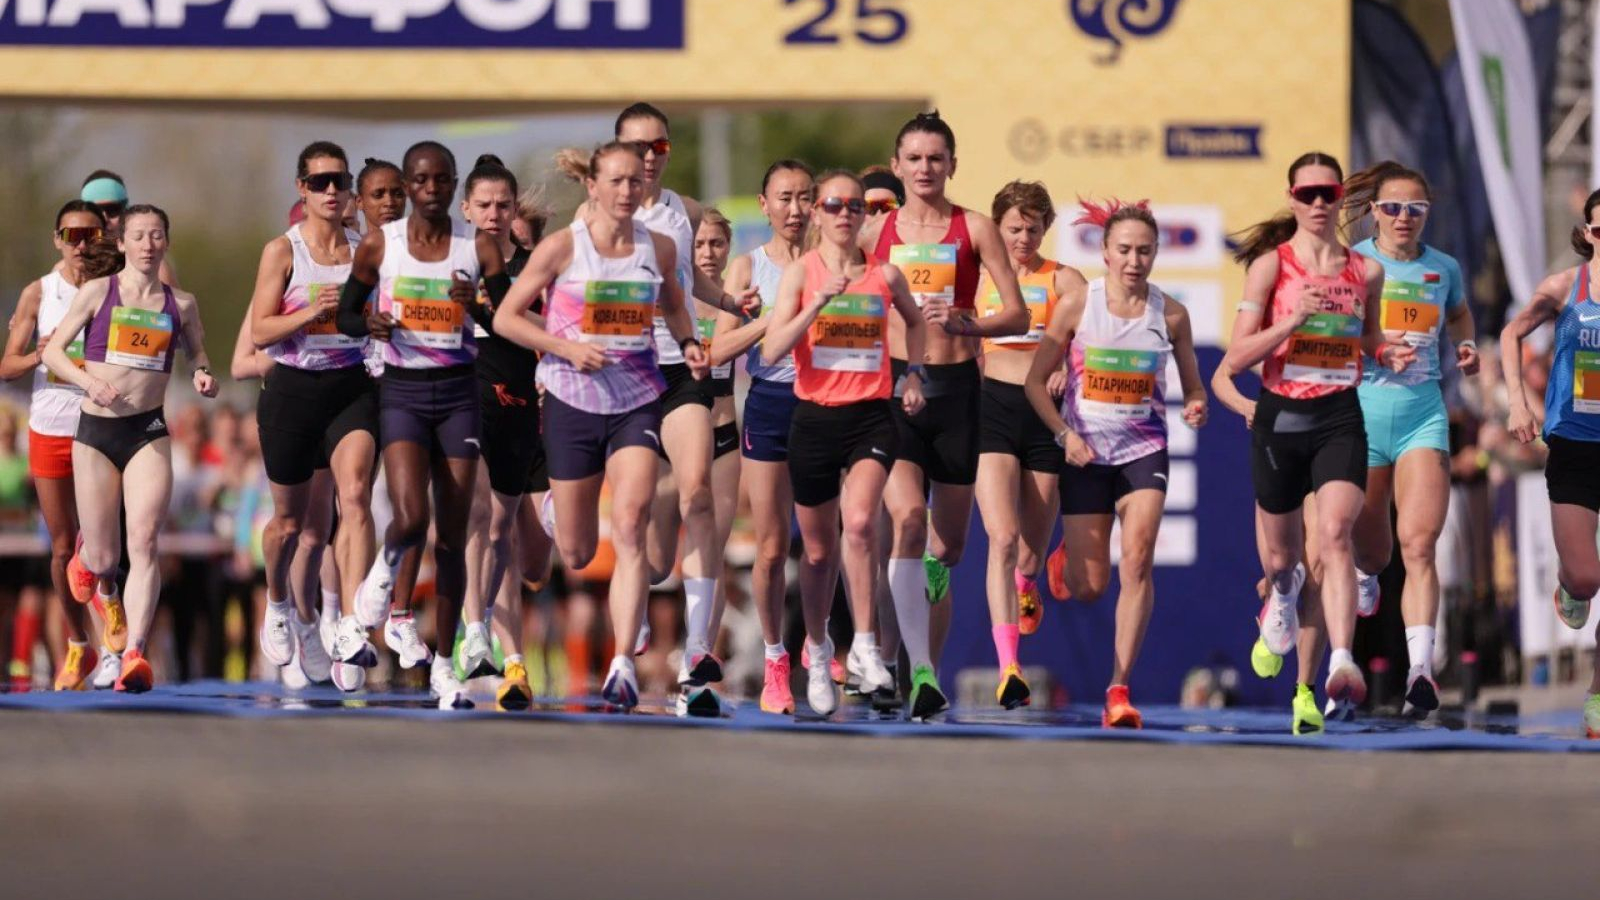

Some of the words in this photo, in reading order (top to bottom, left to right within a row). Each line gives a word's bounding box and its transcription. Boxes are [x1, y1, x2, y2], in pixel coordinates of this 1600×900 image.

[783, 0, 908, 45] 25
[912, 269, 931, 285] 22
[403, 304, 452, 322] CHERONO
[592, 308, 644, 325] КОВАЛЕВА
[1404, 307, 1417, 323] 19
[816, 320, 881, 339] ПРОКОПЬЕВА
[131, 331, 149, 348] 24
[1293, 338, 1353, 358] ДМИТРИЕВА
[1088, 374, 1150, 395] ТАТАРИНОВА
